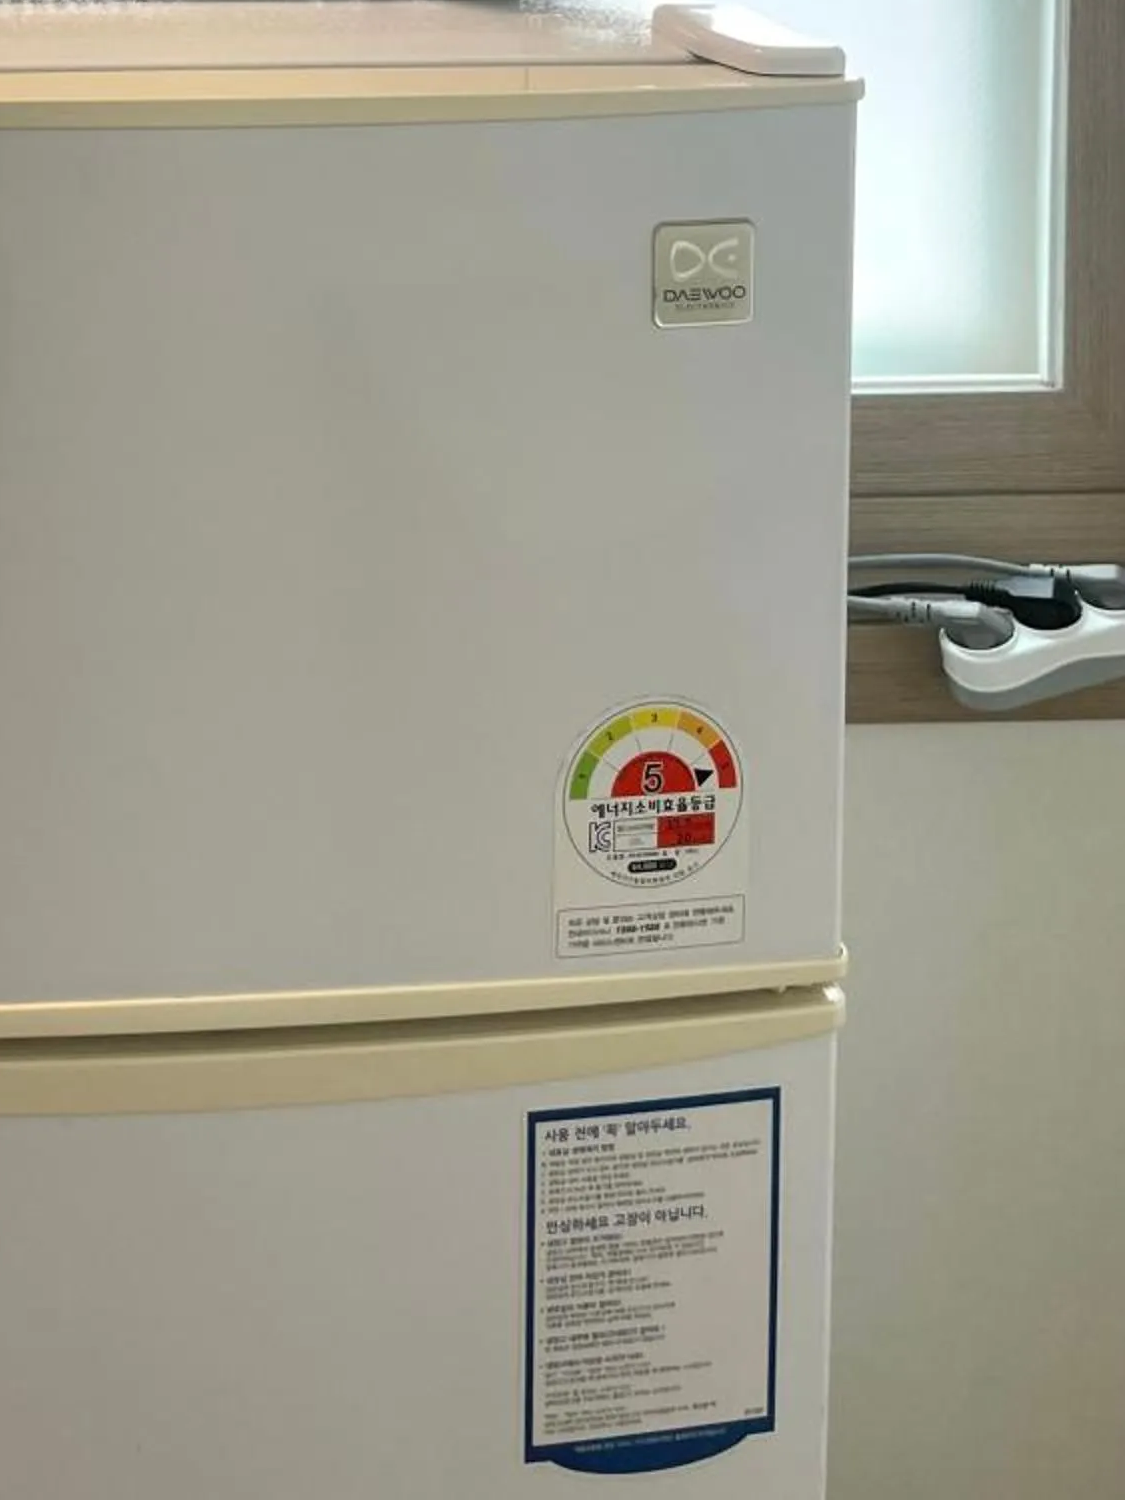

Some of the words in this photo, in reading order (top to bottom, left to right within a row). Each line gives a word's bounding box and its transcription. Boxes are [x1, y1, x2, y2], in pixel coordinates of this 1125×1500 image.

[662, 285, 746, 303] DAEWOO
[642, 761, 664, 794] 5
[590, 794, 716, 818] 에너지소비효율등급
[545, 1127, 570, 1142] 사용
[575, 1125, 600, 1142] 전에
[546, 1215, 610, 1235] 안심하세요
[654, 1205, 708, 1222] 아닙니다.
